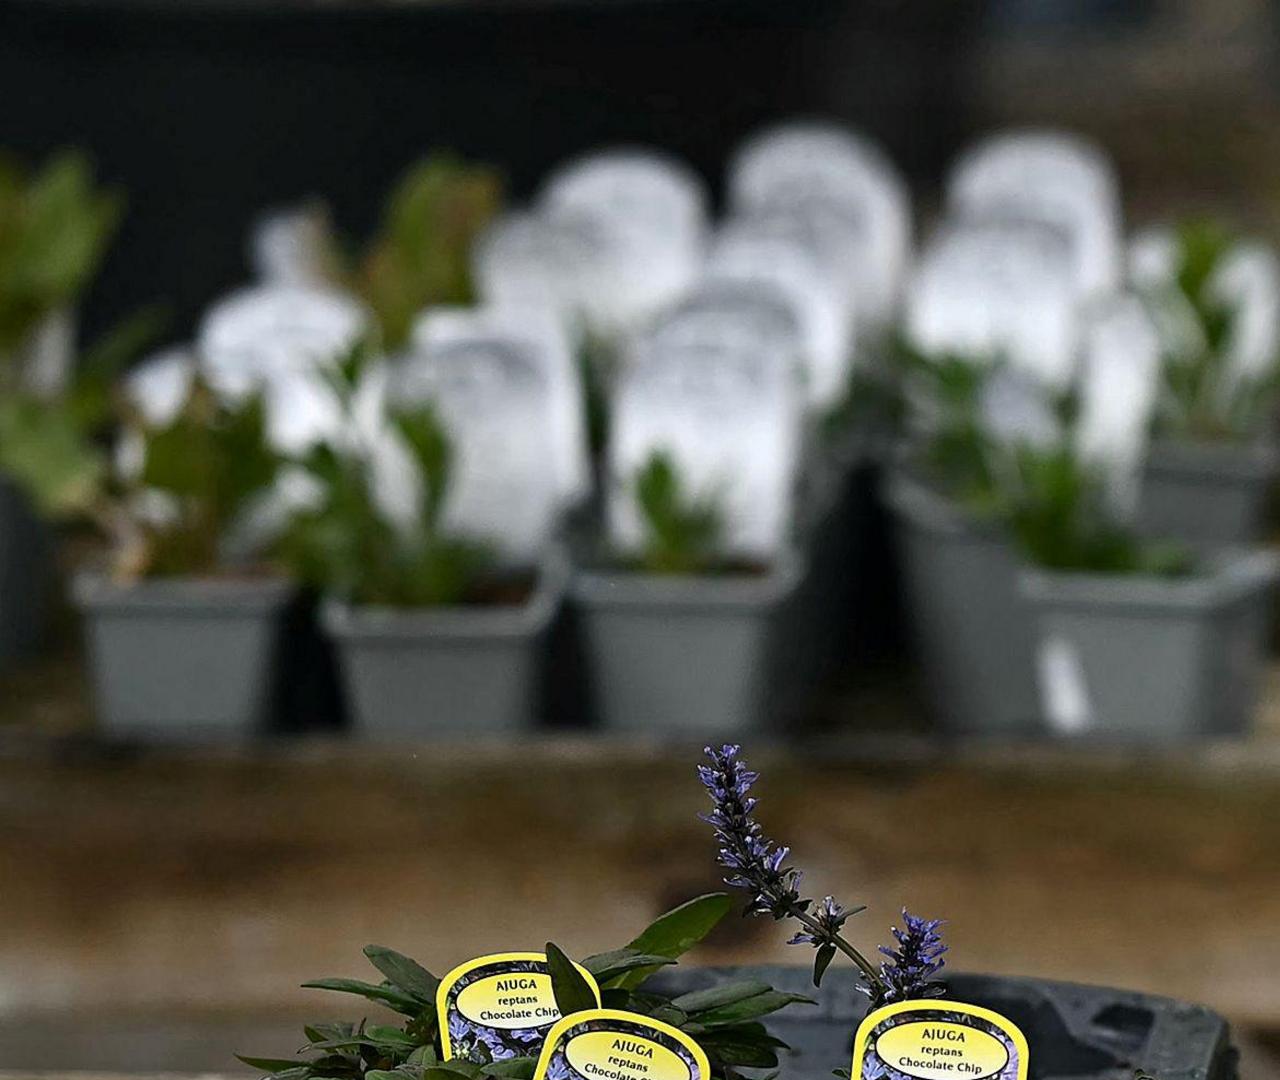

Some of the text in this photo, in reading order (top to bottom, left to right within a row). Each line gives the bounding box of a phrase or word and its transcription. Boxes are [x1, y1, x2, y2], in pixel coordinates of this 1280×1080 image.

[496, 978, 537, 991] AJUGA
[498, 994, 538, 1006] reptans
[480, 1007, 559, 1021] Chocolate Chip
[921, 1028, 966, 1043] AJUGA
[611, 1038, 654, 1059] AJUGA
[920, 1045, 963, 1058] reptans
[607, 1055, 649, 1073] reptans
[899, 1057, 983, 1075] Chocolate Chip
